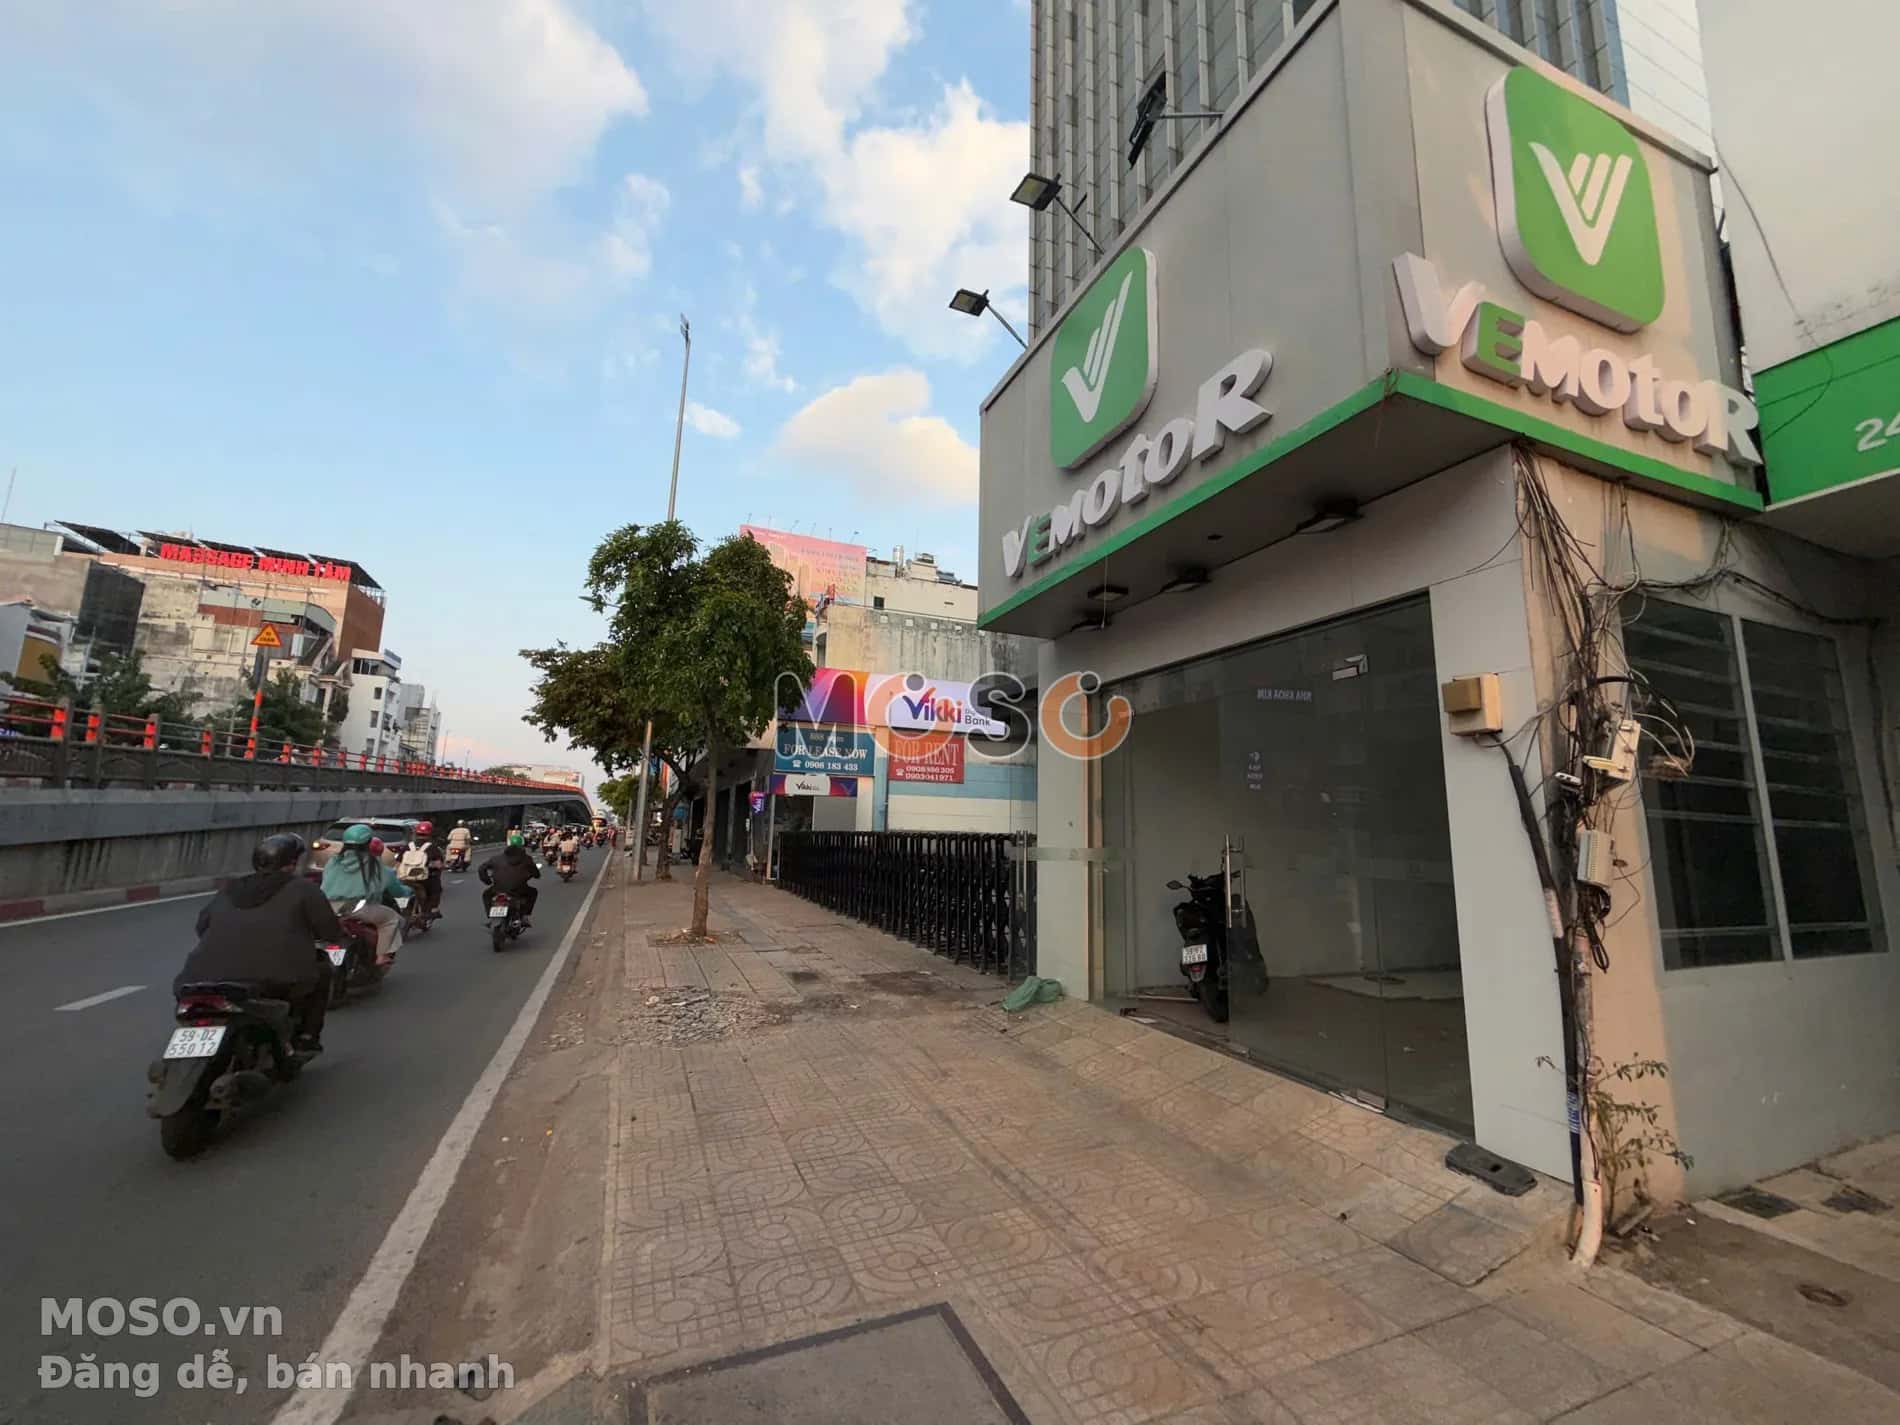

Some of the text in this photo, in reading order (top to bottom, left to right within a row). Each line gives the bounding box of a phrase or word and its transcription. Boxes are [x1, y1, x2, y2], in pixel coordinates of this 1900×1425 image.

[160, 543, 254, 569] MASSAGE
[258, 556, 310, 577] MINH
[902, 687, 962, 724] Vikki
[965, 715, 991, 726] Bank
[893, 740, 960, 766] FOR RENT
